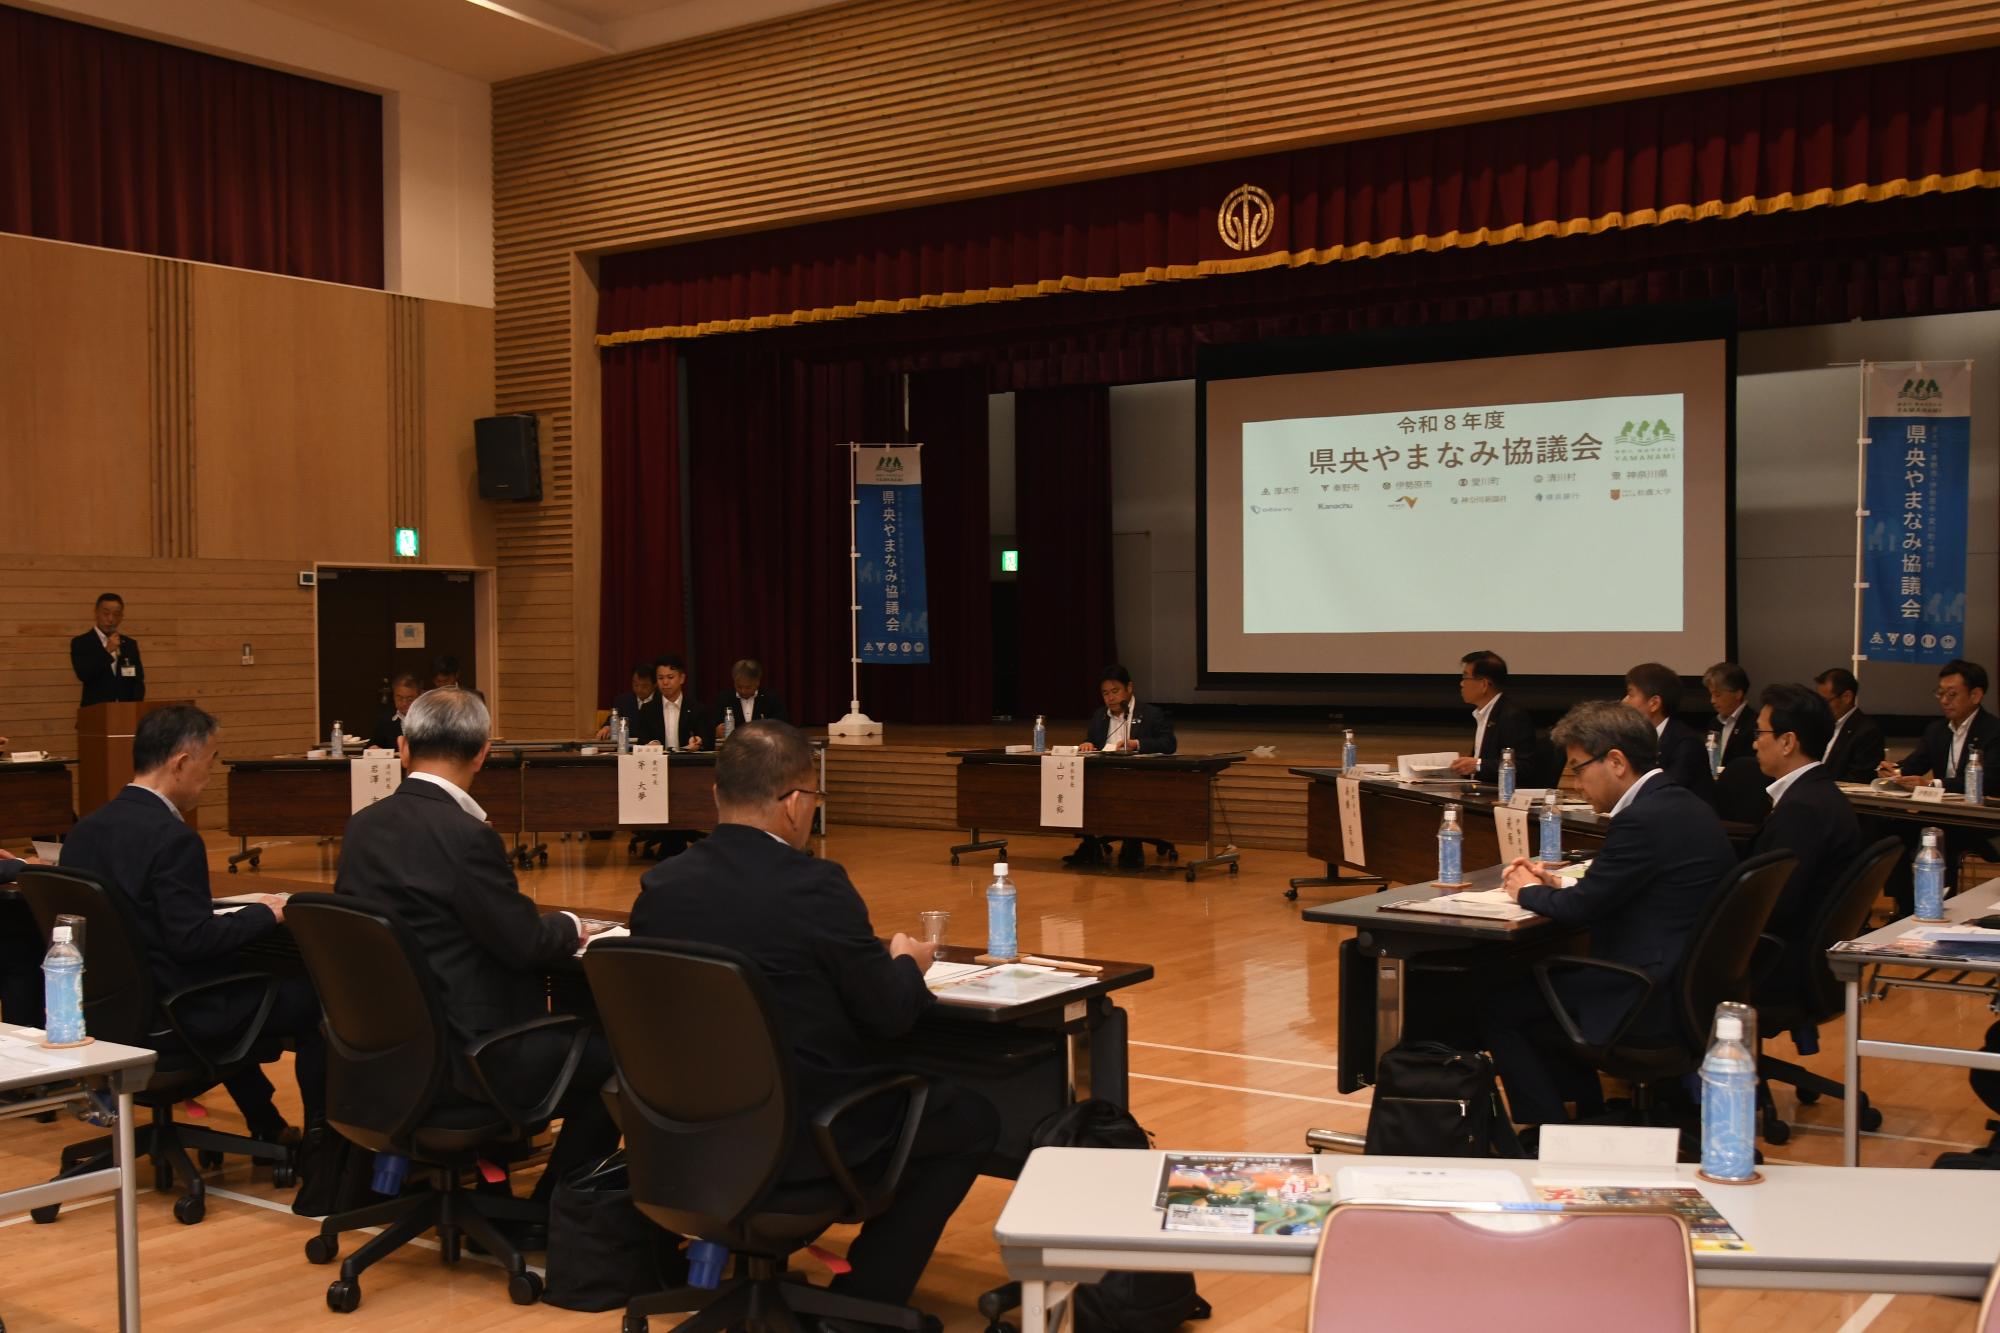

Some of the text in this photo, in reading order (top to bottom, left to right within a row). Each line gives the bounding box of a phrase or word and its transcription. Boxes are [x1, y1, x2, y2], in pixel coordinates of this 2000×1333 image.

[1309, 432, 1603, 475] 県央やまなみ協議会
[1395, 480, 1432, 490] 伊勢原市
[1626, 469, 1668, 480] 神奈川県
[1317, 502, 1353, 511] Kanachu
[1901, 425, 1926, 618] 県央やまなみ協議会
[883, 491, 899, 631] 県央やまなみ協議会
